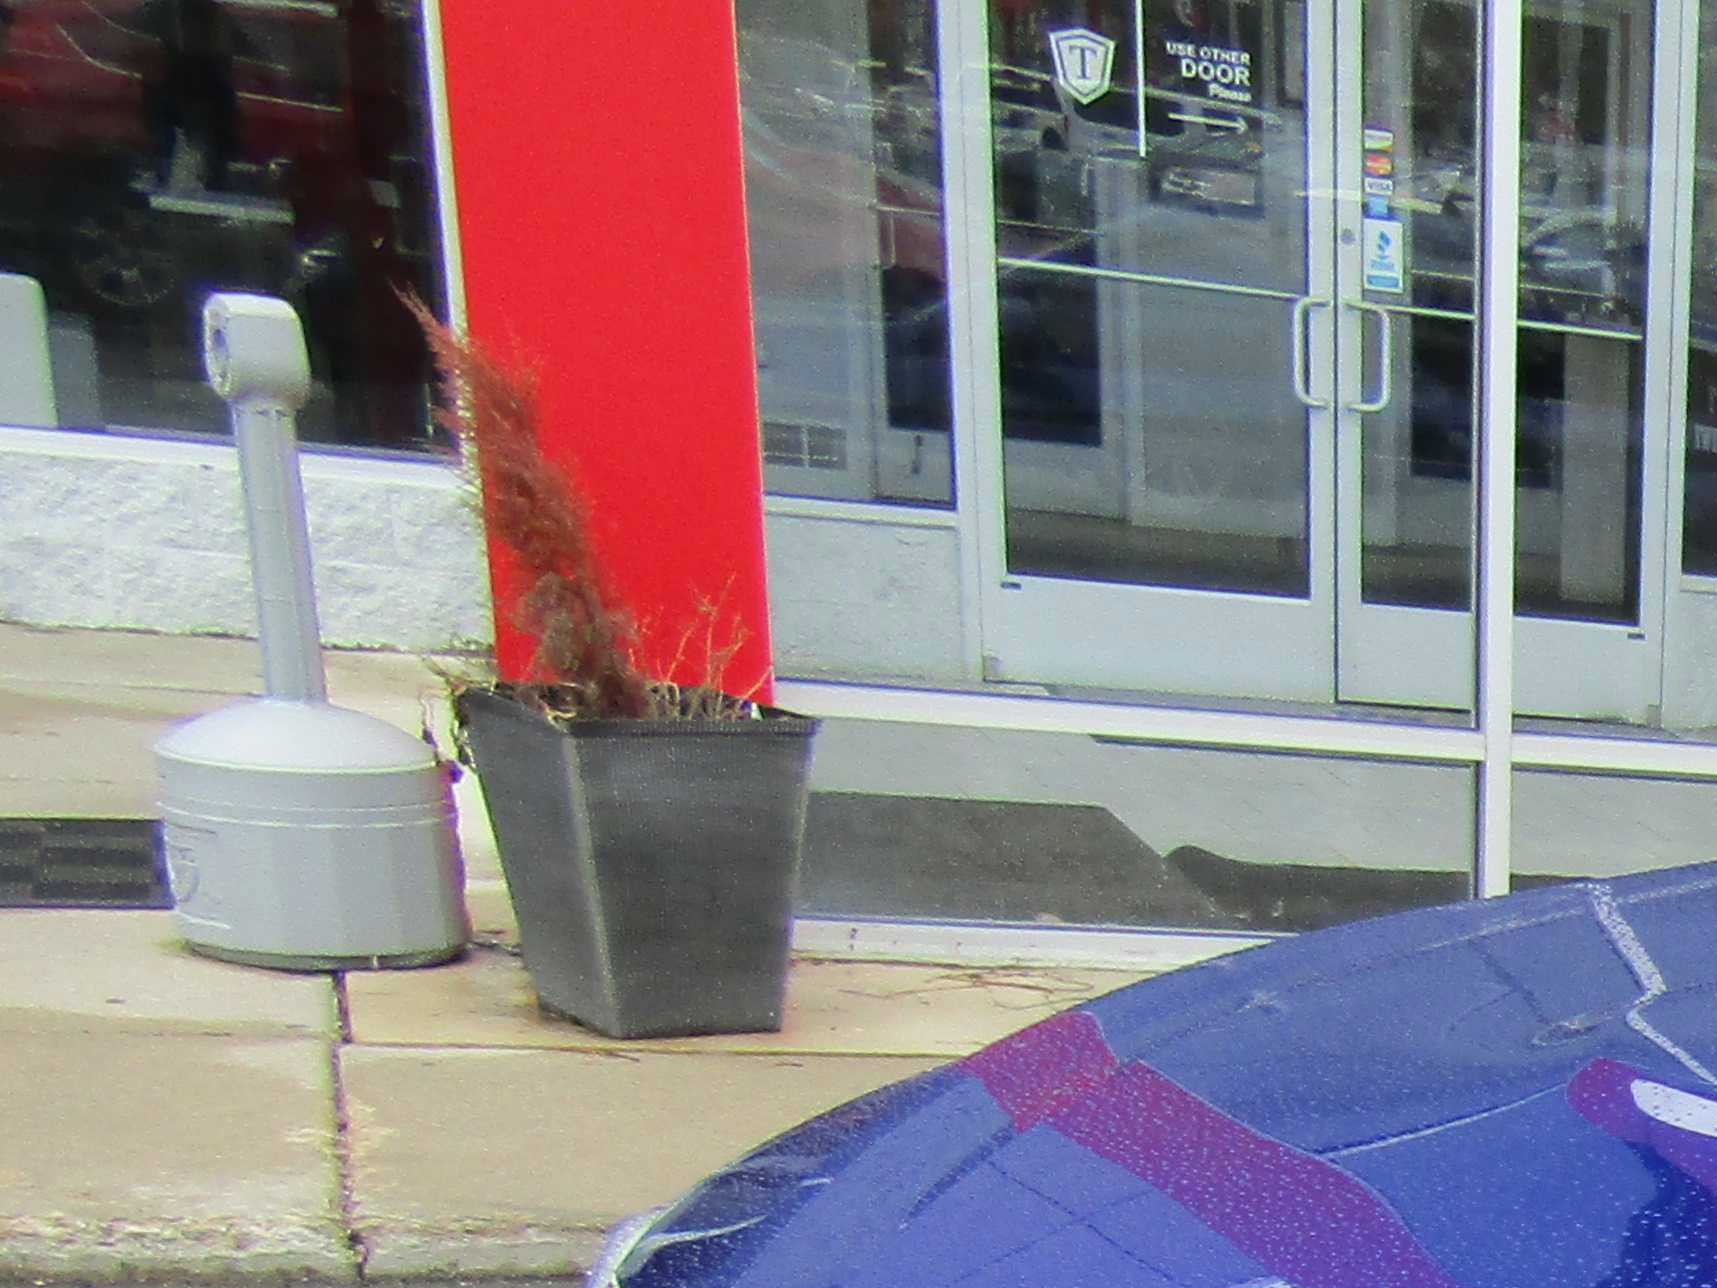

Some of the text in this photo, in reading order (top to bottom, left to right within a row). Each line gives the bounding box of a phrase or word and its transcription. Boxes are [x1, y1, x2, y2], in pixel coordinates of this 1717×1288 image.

[1070, 46, 1096, 80] T
[1166, 41, 1251, 65] USE OTHER
[1181, 58, 1251, 86] DOOR
[1366, 181, 1393, 193] VISA
